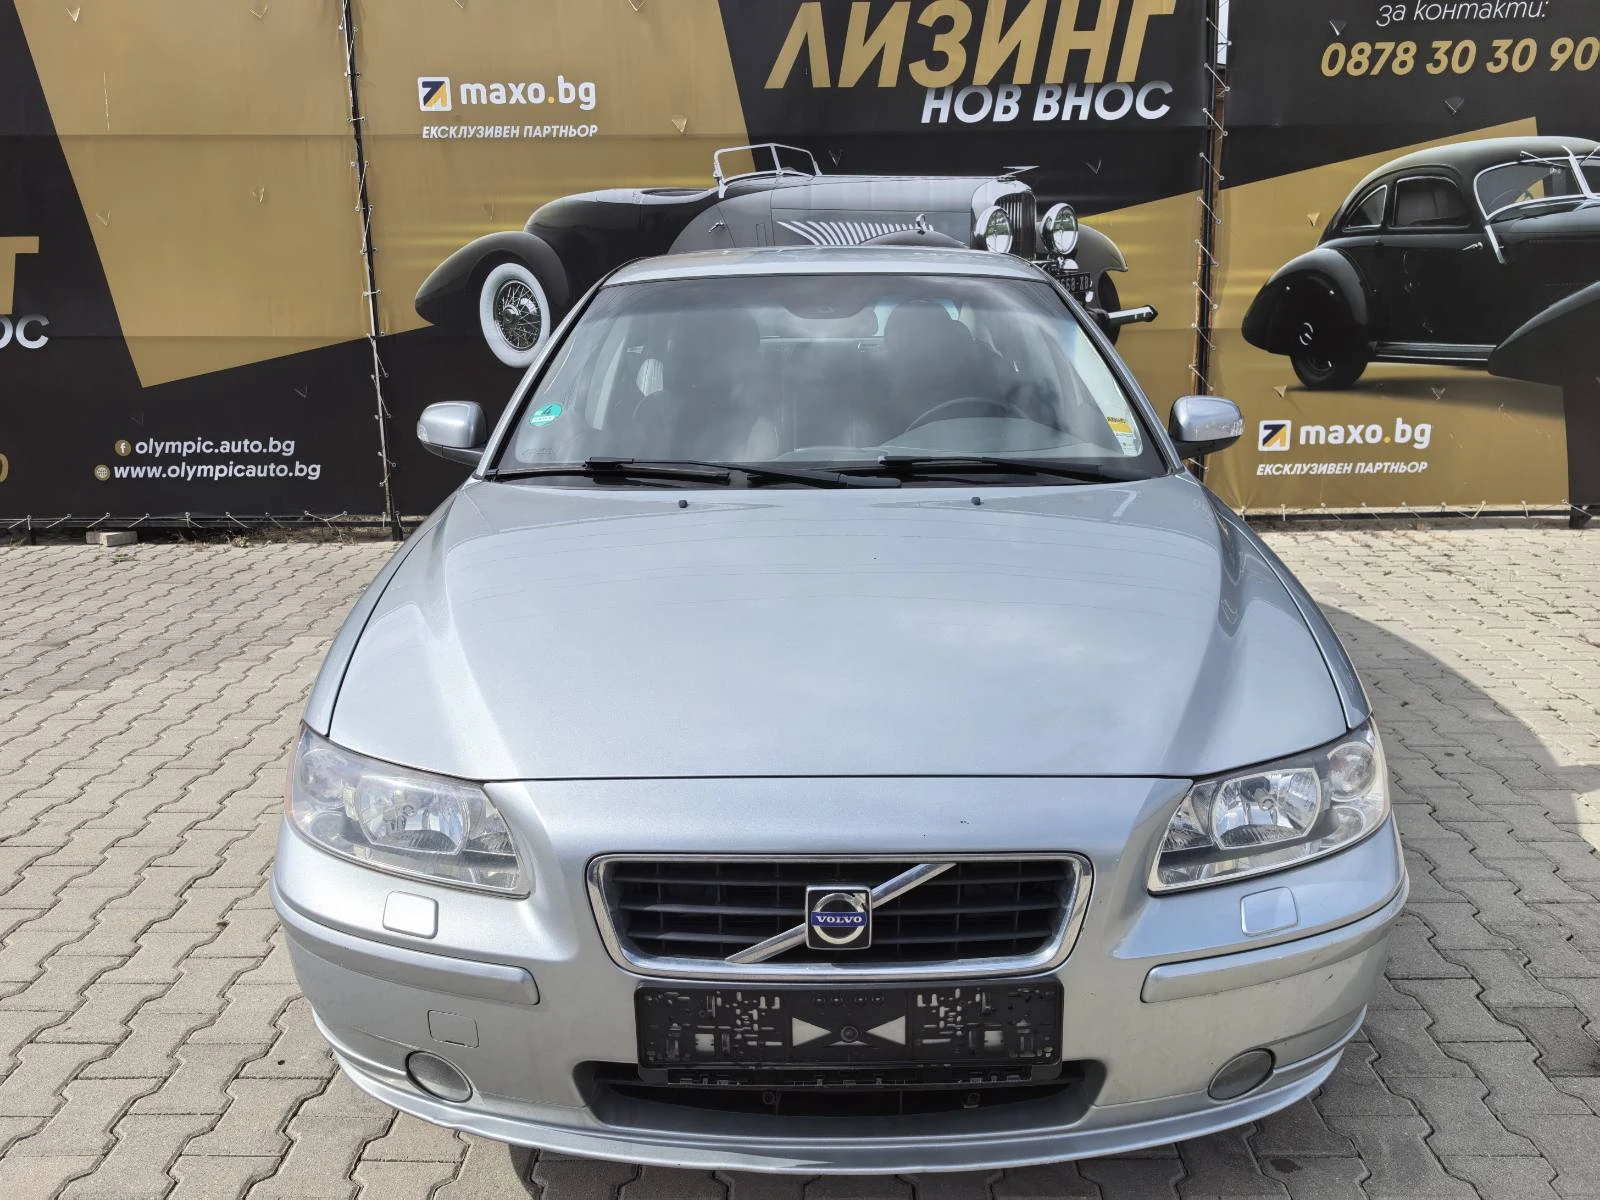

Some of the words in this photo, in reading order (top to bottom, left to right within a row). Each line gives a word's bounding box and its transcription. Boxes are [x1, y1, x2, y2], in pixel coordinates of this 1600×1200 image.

[1376, 4, 1405, 26] за
[764, 0, 1177, 88] ЛИЗИНГ
[1321, 41, 1417, 77] 0878
[1426, 39, 1477, 74] 30
[1486, 37, 1537, 73] 30
[1550, 36, 1600, 72] 90
[460, 75, 596, 111] maxo.bg
[920, 82, 1022, 124] НОВ
[1033, 79, 1175, 121] ВНОС
[422, 126, 520, 139] ЕКСКЛУЗИВЕН
[523, 124, 598, 138] ПАРТНЬОР
[1299, 417, 1432, 450] maxo.bg
[135, 437, 296, 457] olympic.auto.bg
[114, 460, 322, 481] www.olympicauto.bg
[1256, 463, 1352, 476] ЕКСКЛУЗИВЕН
[1354, 461, 1428, 474] ПАРТНЬОР
[816, 915, 863, 923] VOLVO
